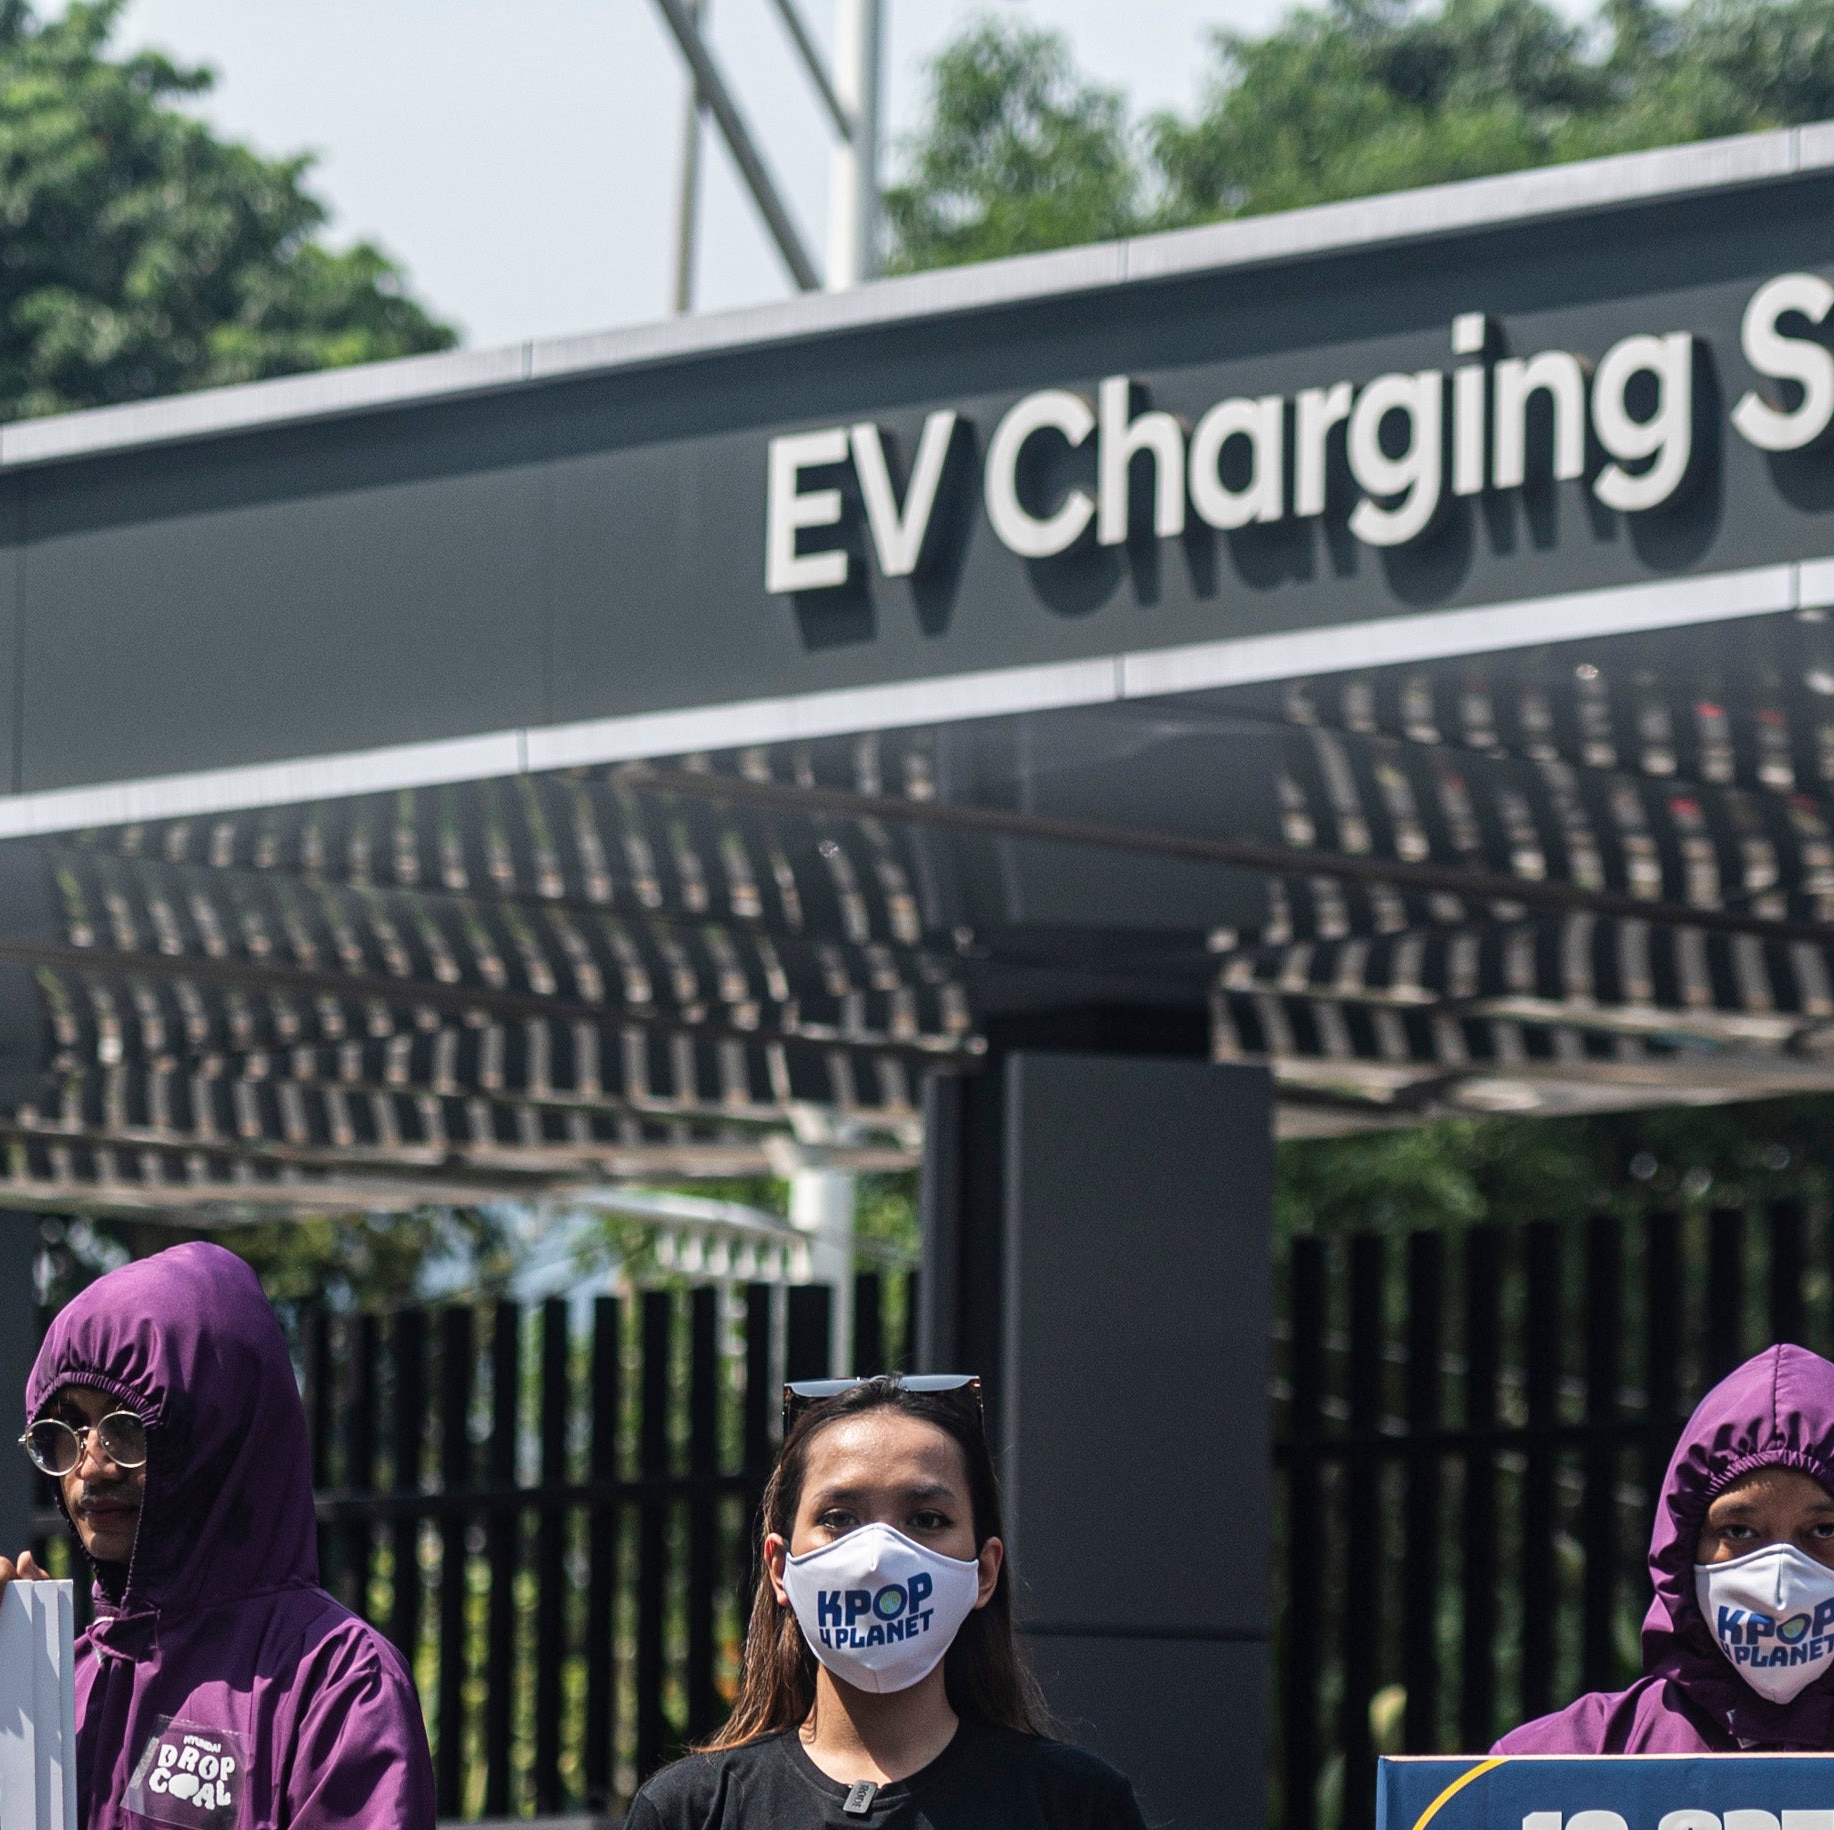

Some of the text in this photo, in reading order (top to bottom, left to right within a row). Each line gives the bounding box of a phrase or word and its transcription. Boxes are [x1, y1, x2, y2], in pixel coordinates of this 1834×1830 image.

[765, 411, 957, 594] EV
[985, 311, 1695, 549] Charging
[817, 1572, 933, 1627] KPOP
[819, 1608, 934, 1649] 4 PLANET
[157, 1744, 236, 1782] DROP
[148, 1767, 231, 1811] COAL
